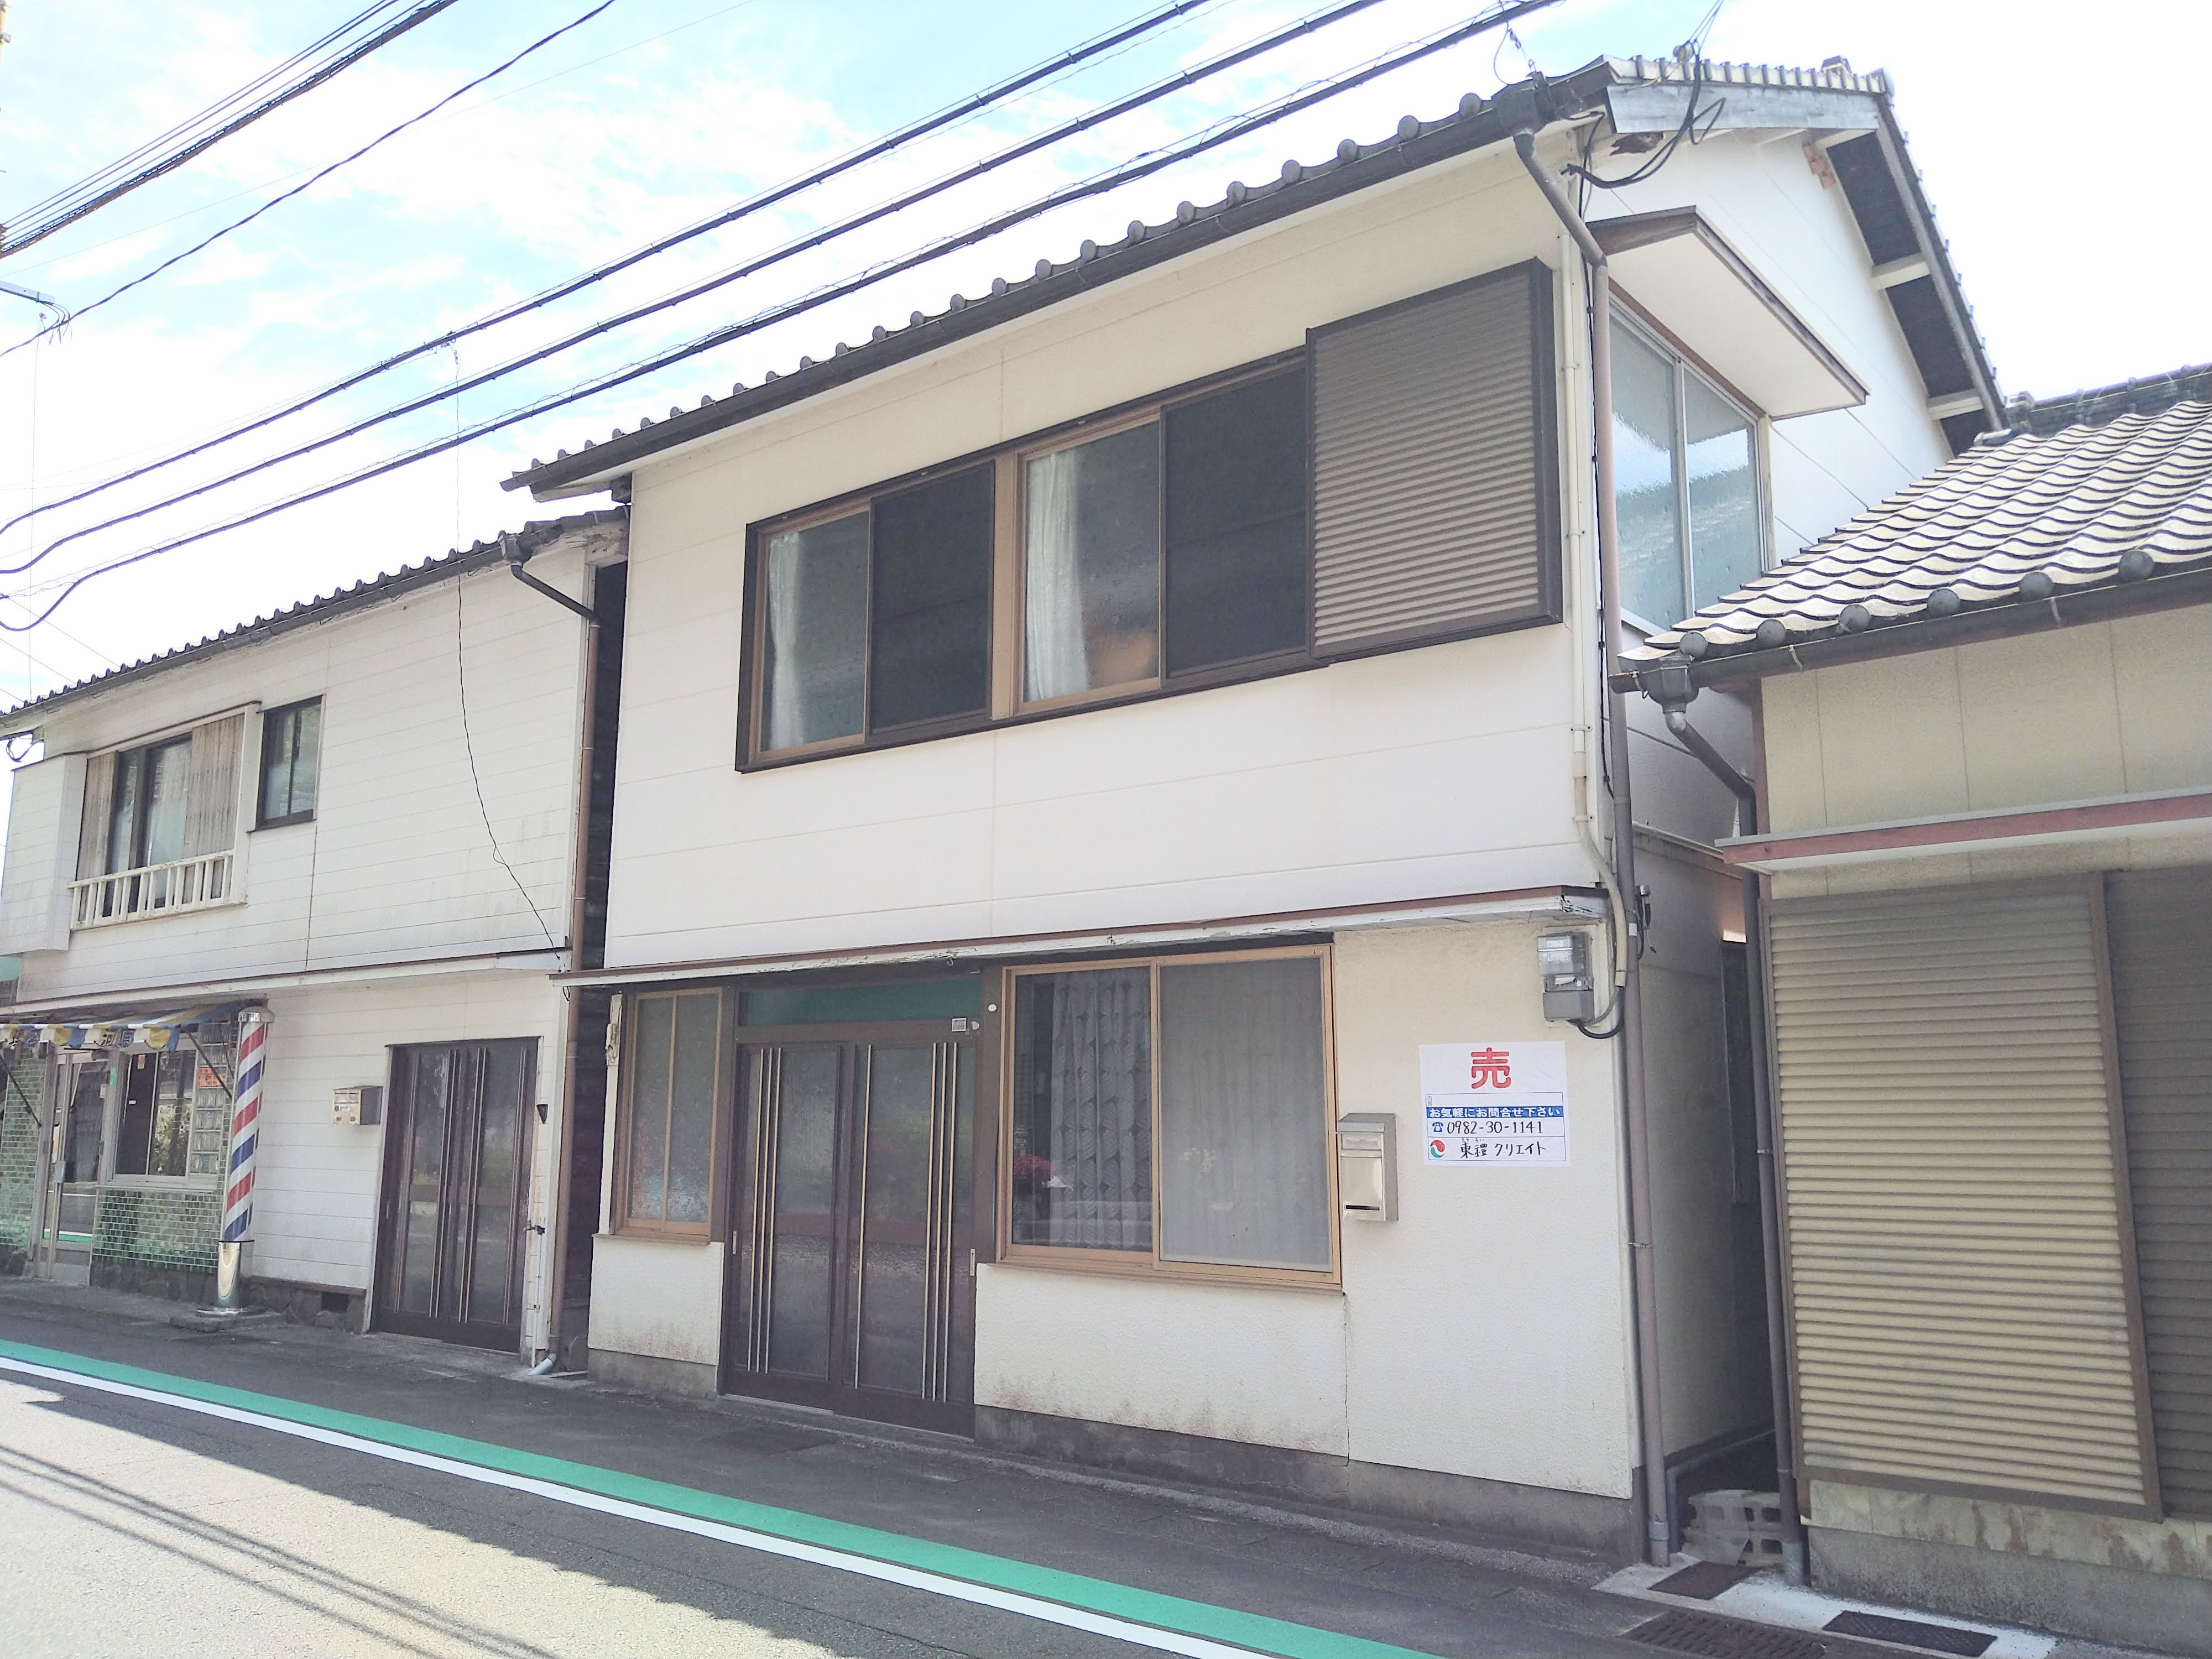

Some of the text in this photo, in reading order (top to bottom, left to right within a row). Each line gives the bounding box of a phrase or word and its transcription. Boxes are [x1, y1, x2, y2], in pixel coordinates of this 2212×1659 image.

[1470, 1047, 1511, 1089] 売
[1429, 1107, 1561, 1118] お気軽にお問合せ下さい
[1447, 1120, 1543, 1135] 0982-30-1141
[1494, 1141, 1547, 1157] クリエイト
